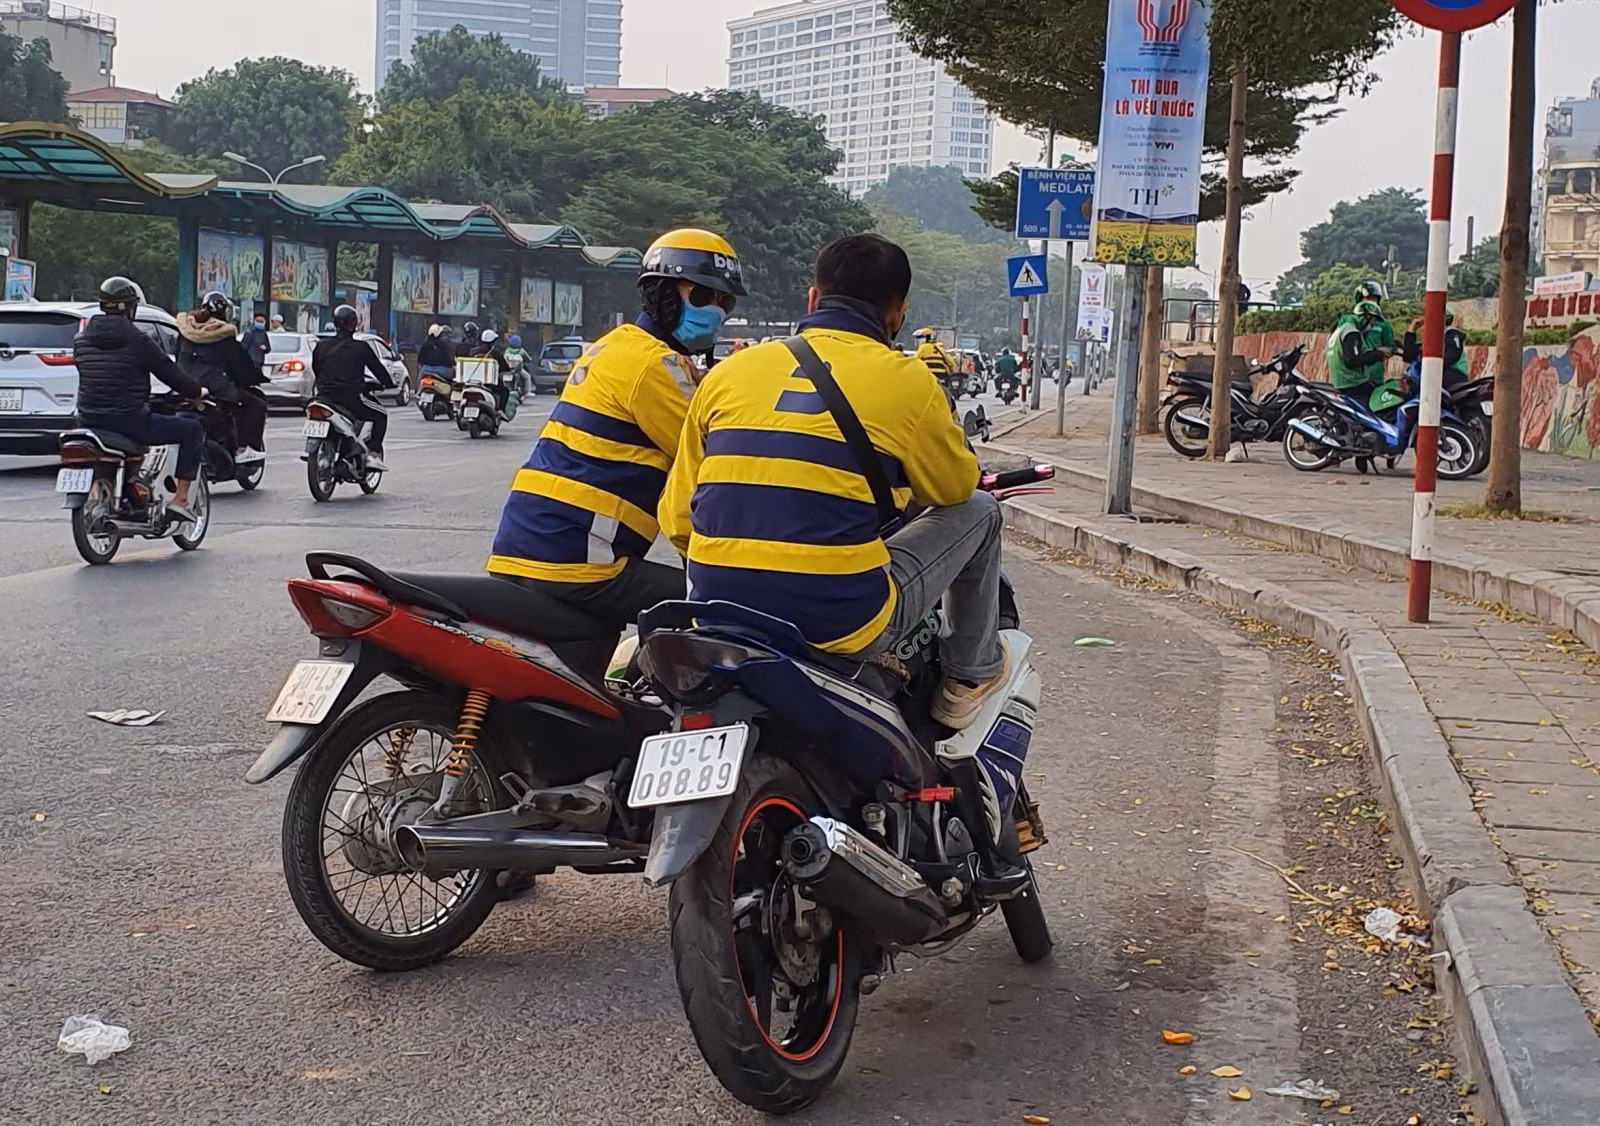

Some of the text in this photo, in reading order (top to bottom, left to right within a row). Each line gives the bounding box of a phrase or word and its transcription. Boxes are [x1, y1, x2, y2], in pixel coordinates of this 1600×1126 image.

[1131, 79, 1150, 95] THI
[1115, 96, 1195, 118] LÀ YÊU NƯỚC
[1129, 188, 1159, 206] TH
[1022, 224, 1038, 233] 500
[896, 614, 939, 660] Grab
[660, 732, 728, 768] 19-C1
[637, 762, 732, 801] 088.89
